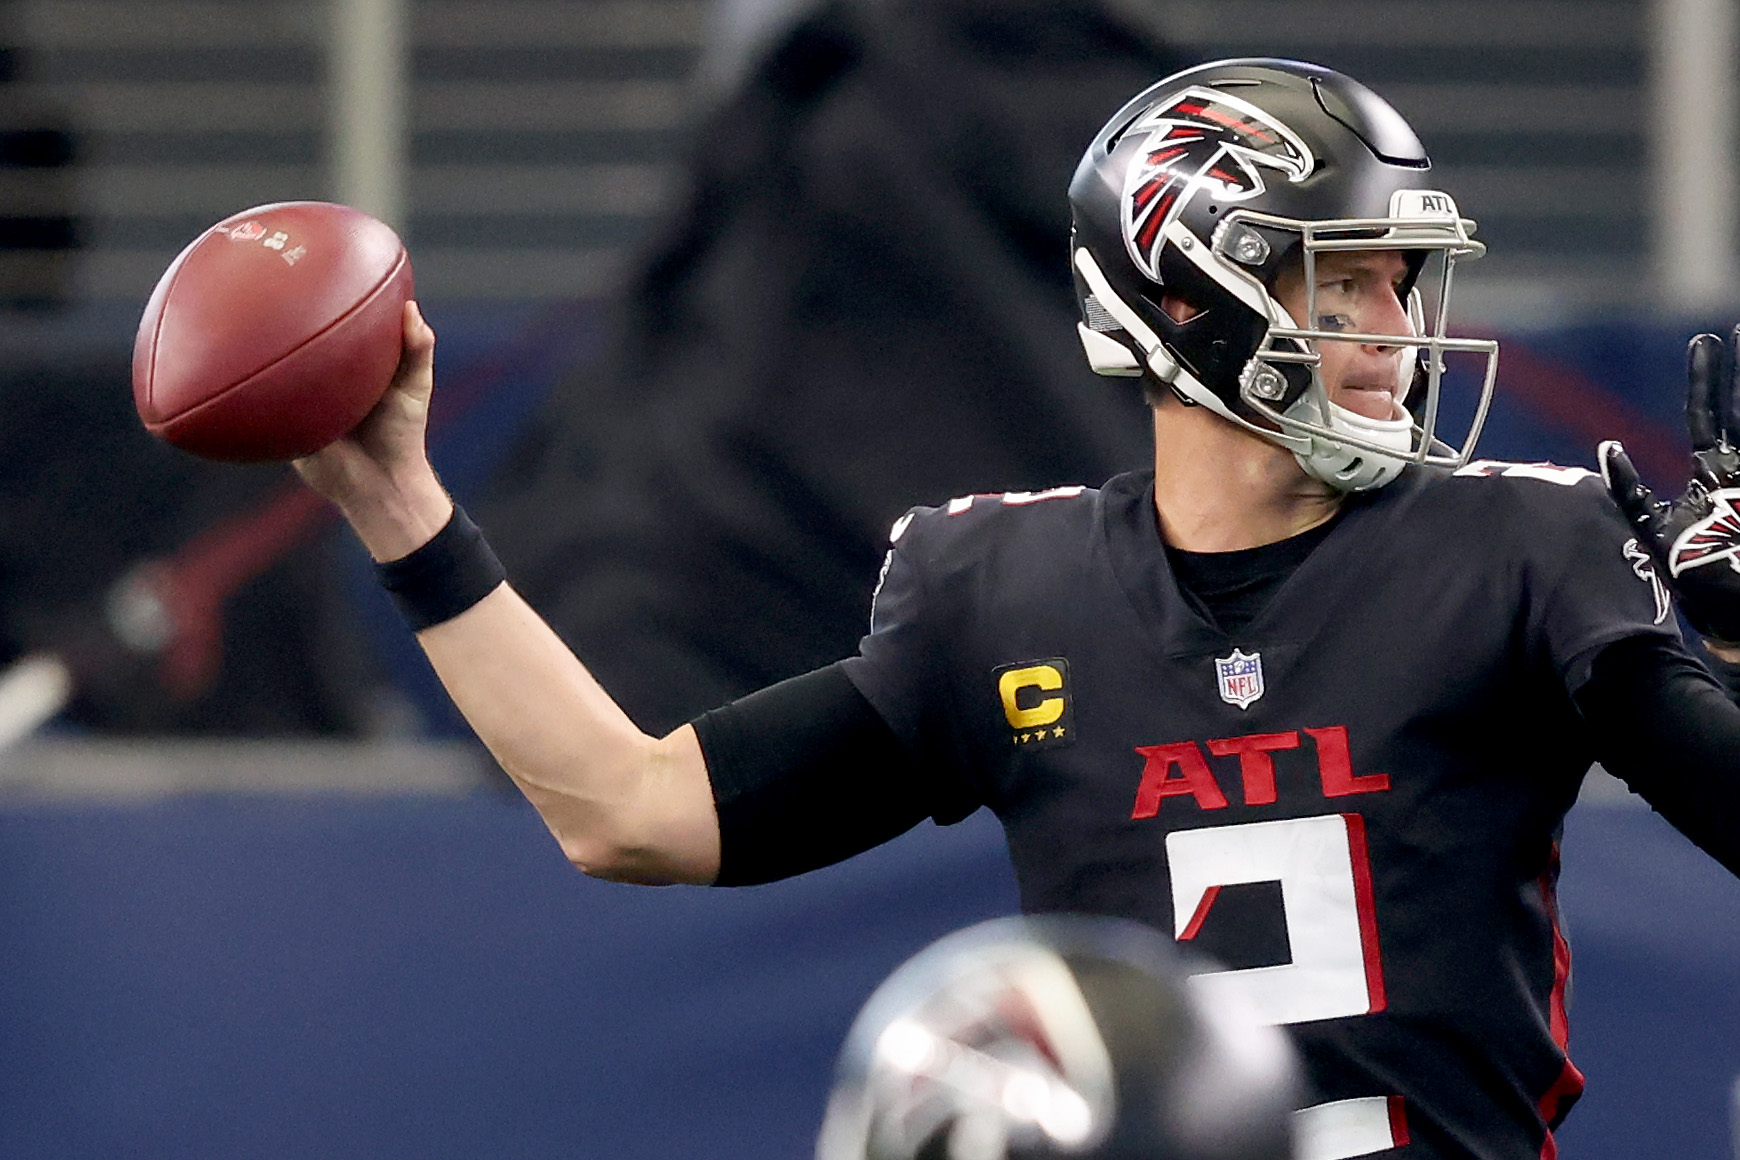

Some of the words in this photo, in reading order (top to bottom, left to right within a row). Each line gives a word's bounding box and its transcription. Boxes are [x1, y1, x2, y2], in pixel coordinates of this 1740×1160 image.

[1421, 195, 1453, 213] ATL
[999, 665, 1066, 729] C
[1227, 676, 1257, 697] NFL
[1131, 725, 1391, 820] ATL
